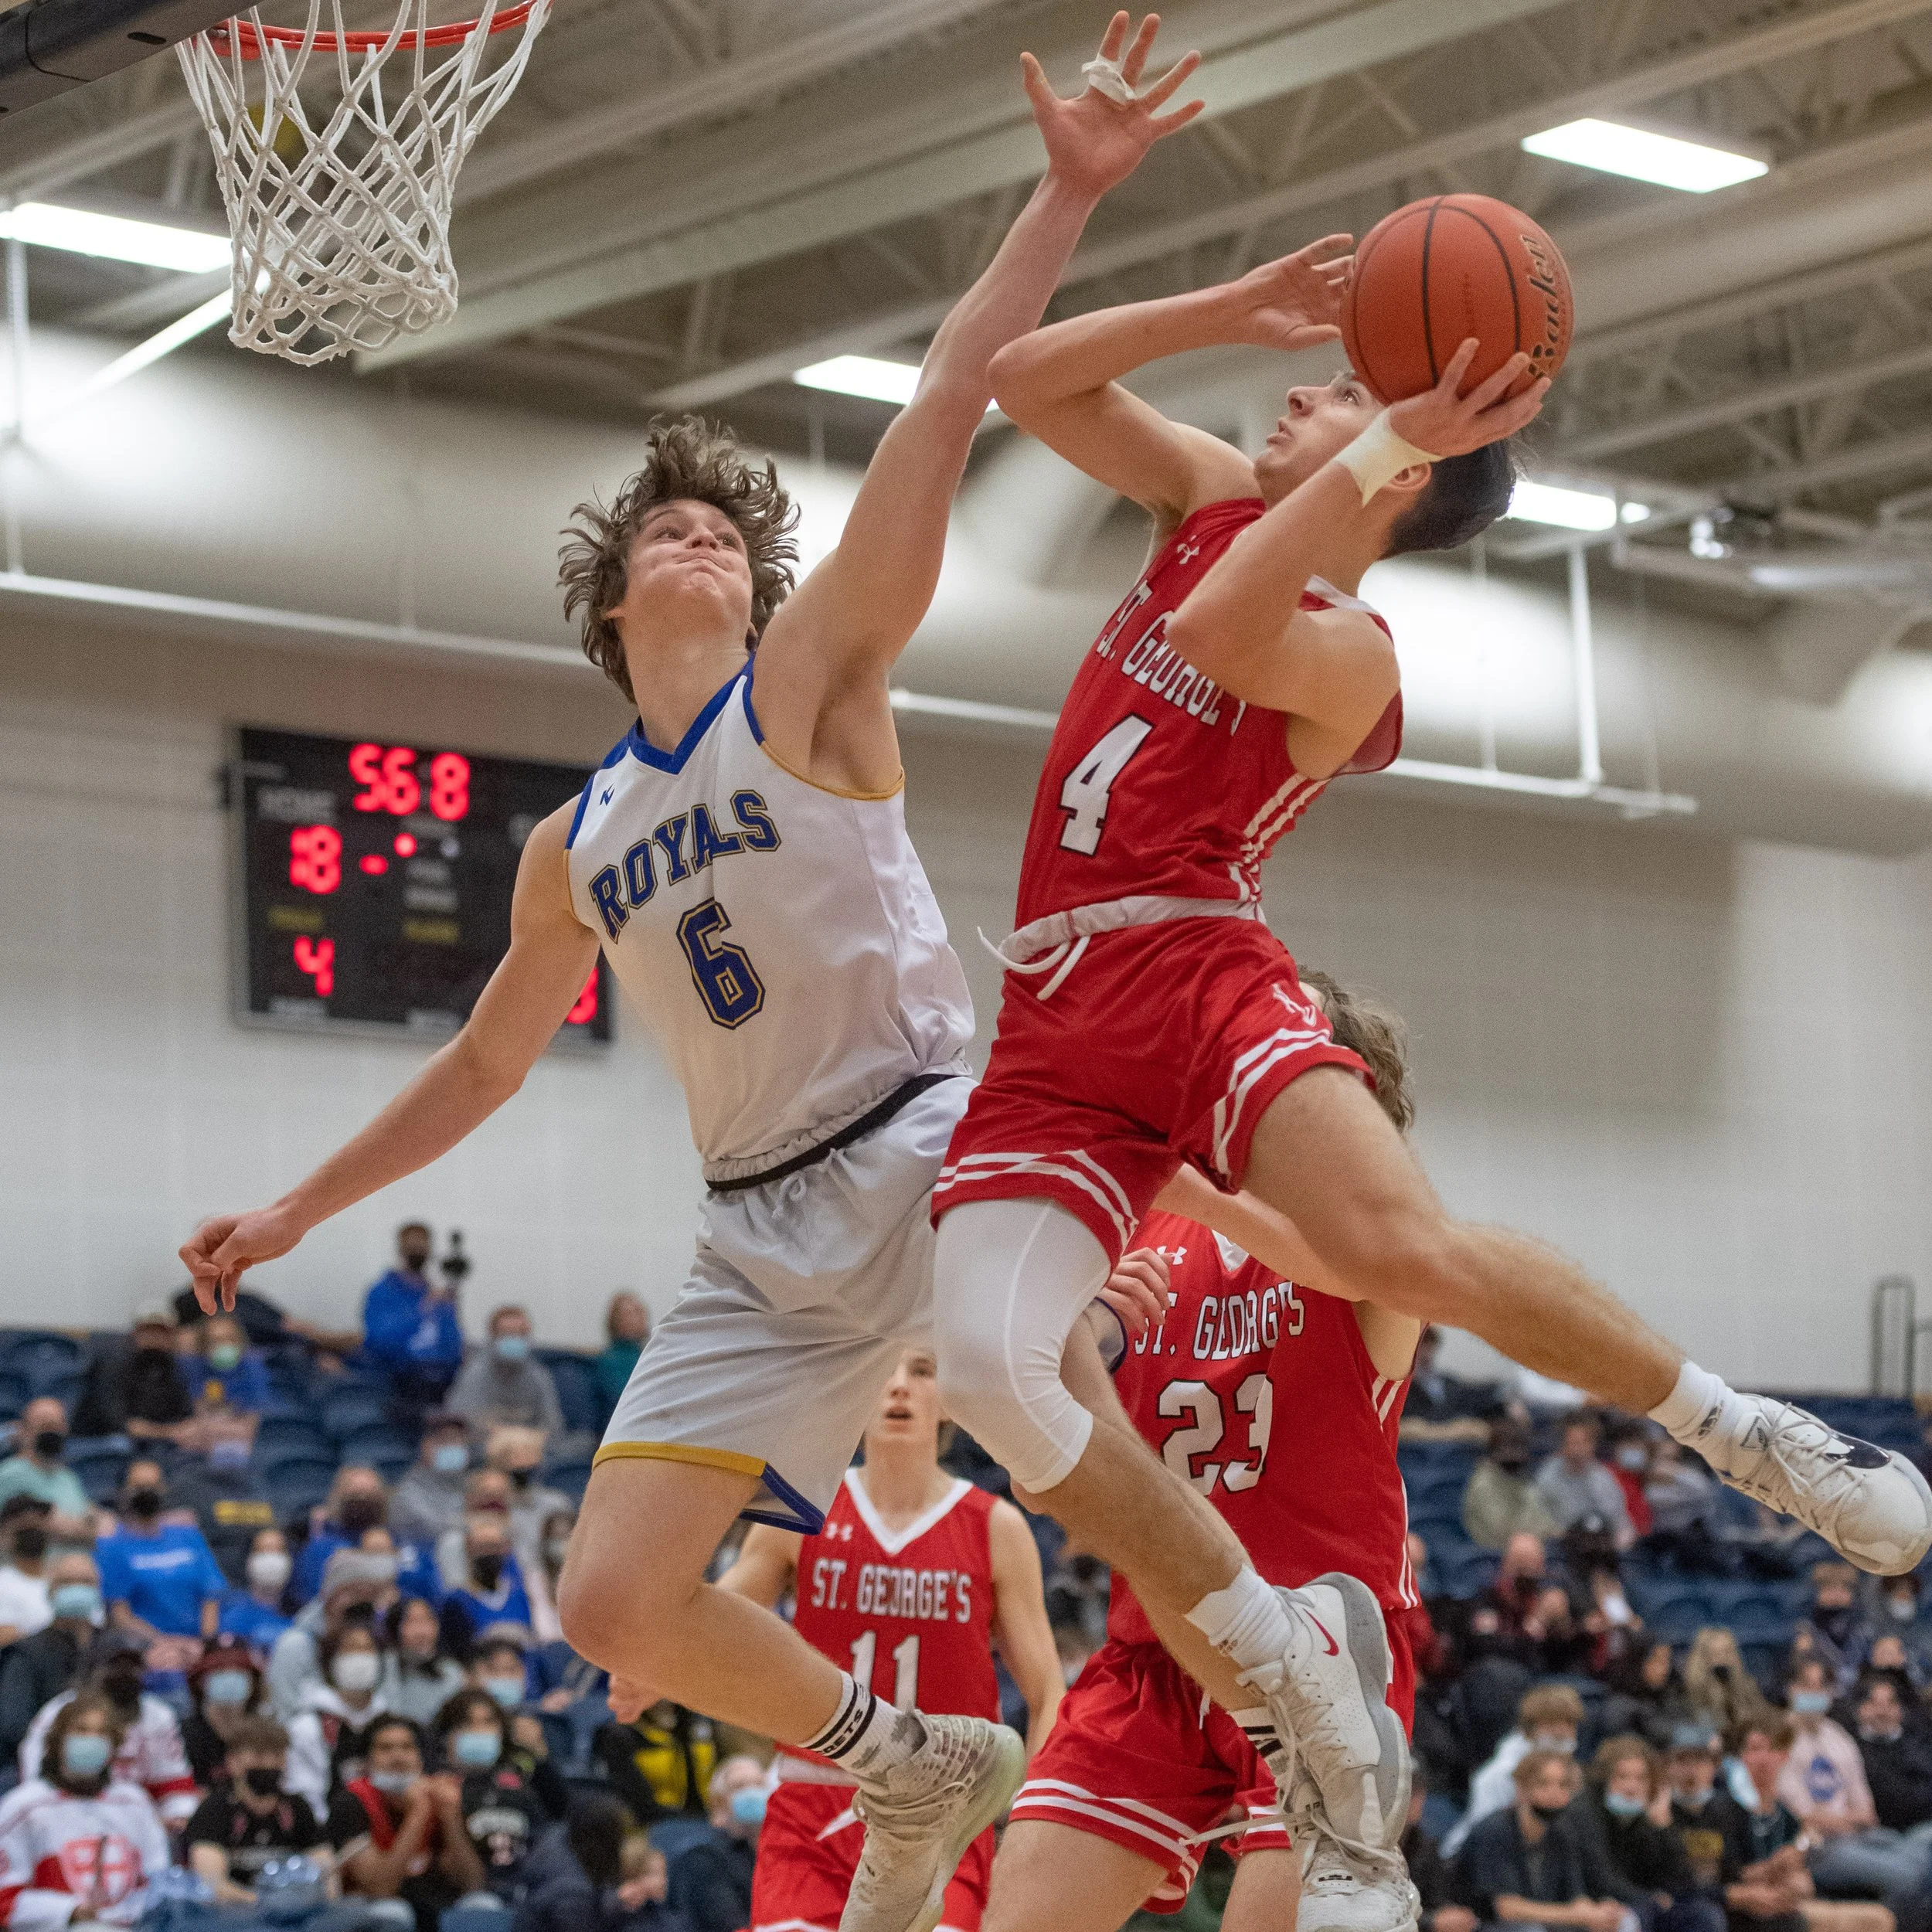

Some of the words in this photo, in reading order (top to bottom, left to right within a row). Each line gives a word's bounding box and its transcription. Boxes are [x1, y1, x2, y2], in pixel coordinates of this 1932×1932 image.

[1121, 610, 1247, 736] GEORG
[1058, 713, 1155, 856] 4
[587, 789, 782, 945] ROYALS
[675, 896, 766, 1030] 6
[1192, 1280, 1304, 1362] GEORGS
[1156, 1372, 1274, 1495] 23
[812, 1557, 848, 1610] ST.
[856, 1563, 972, 1624] GEORGE'S
[850, 1629, 920, 1709] 11
